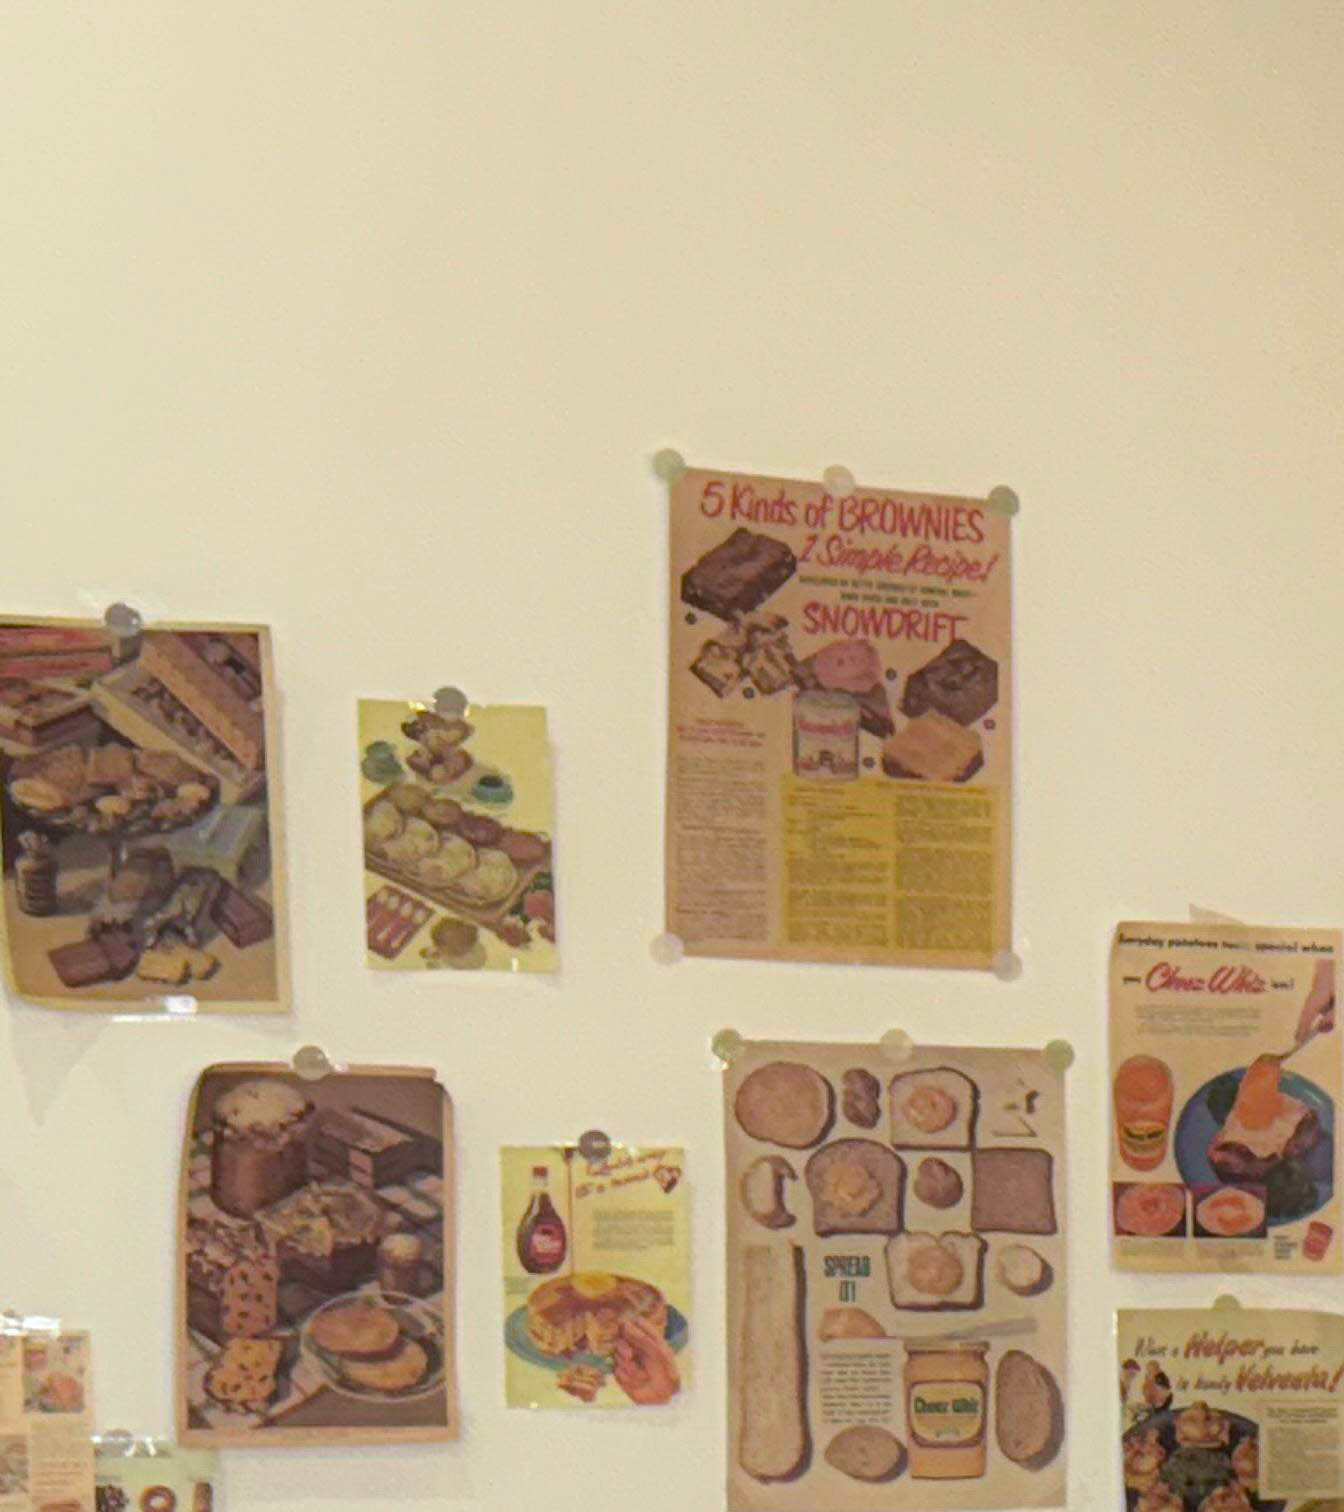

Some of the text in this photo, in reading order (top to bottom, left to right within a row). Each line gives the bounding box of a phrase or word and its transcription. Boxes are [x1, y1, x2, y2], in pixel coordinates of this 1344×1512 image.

[701, 481, 985, 544] 5 Kinds of BROWNIES
[803, 602, 968, 642] SNOWDRIFT
